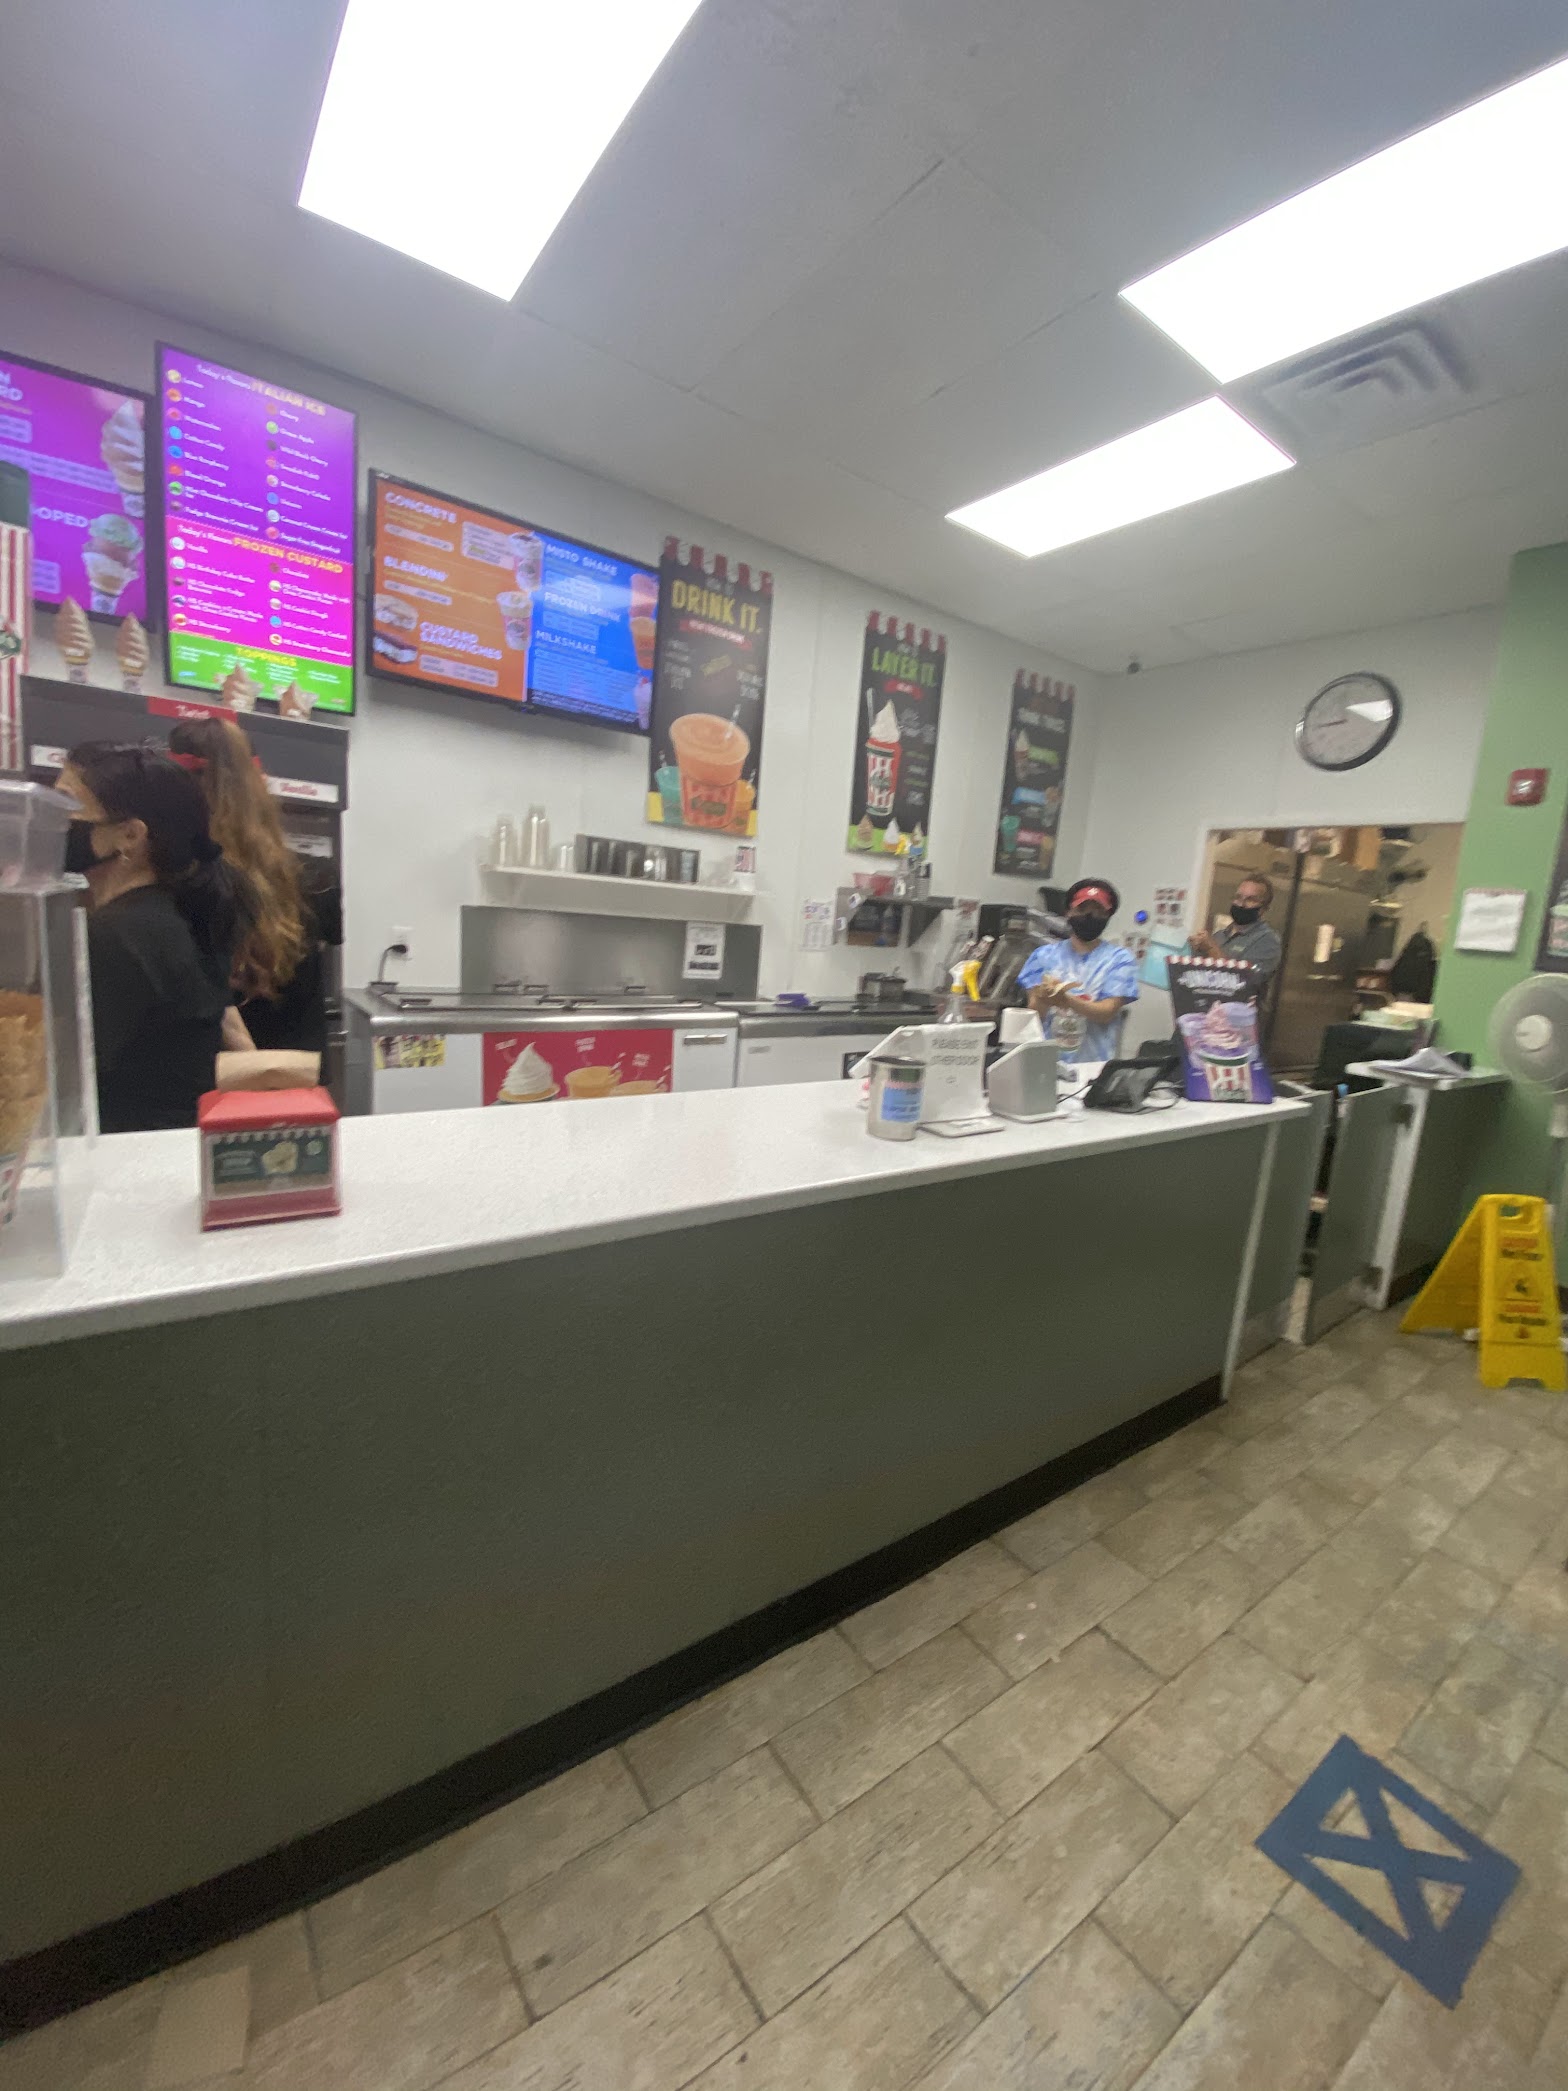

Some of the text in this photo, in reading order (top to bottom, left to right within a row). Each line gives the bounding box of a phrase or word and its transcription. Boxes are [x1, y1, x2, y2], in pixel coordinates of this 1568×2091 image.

[385, 491, 457, 524] CONCRETE
[233, 537, 285, 558] FROZEN
[286, 551, 344, 574] CUSTARD
[582, 556, 618, 576] SHAKE
[544, 591, 588, 613] FROZEN
[671, 579, 736, 626] DRINK
[420, 621, 479, 644] CUSTARD
[535, 630, 597, 655] MILKSHAKE
[236, 646, 297, 667] TOPPINGS
[420, 630, 503, 661] SANDWICHES
